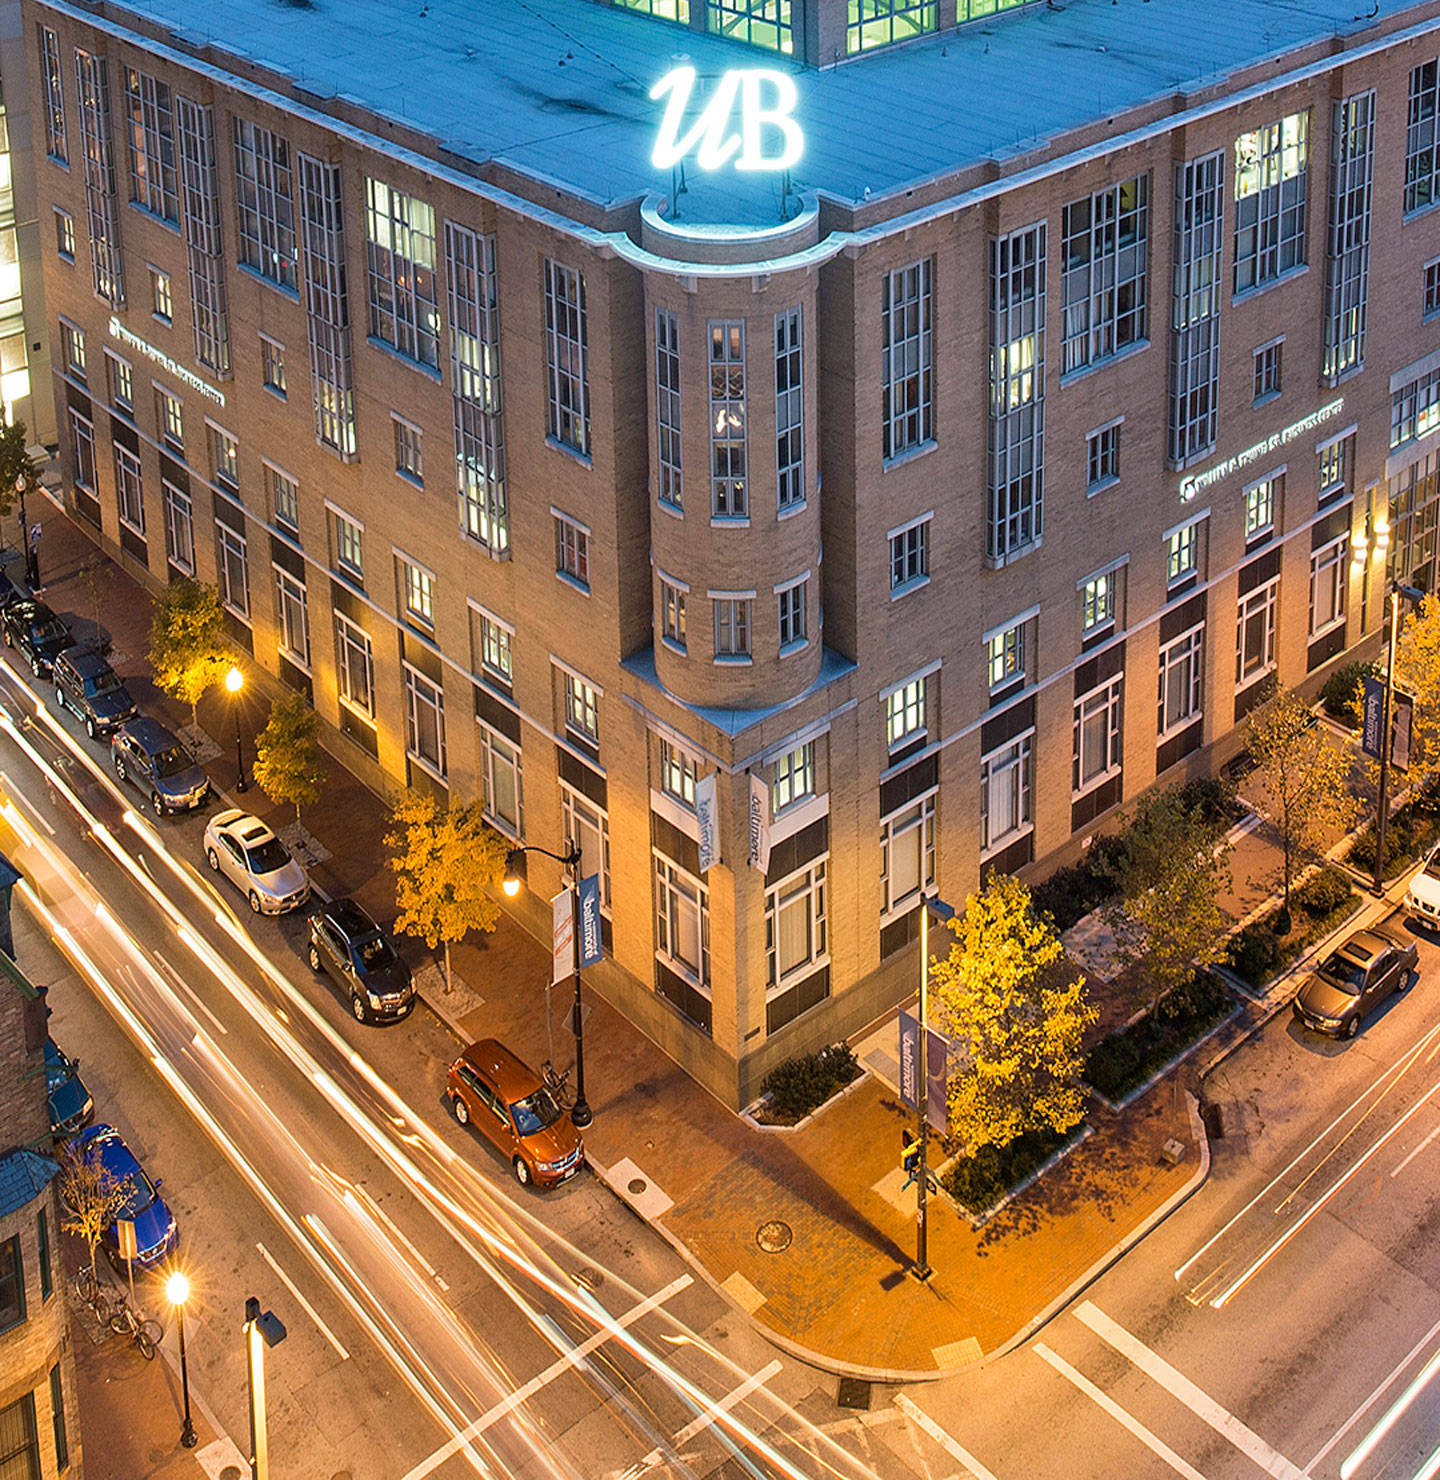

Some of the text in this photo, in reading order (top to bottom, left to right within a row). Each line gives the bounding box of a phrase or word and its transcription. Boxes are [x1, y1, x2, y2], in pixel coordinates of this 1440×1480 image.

[650, 66, 804, 170] UB
[699, 798, 712, 866] baltimore
[752, 795, 763, 861] baltimore
[583, 897, 595, 960] baltimore
[902, 1032, 914, 1099] baltimore
